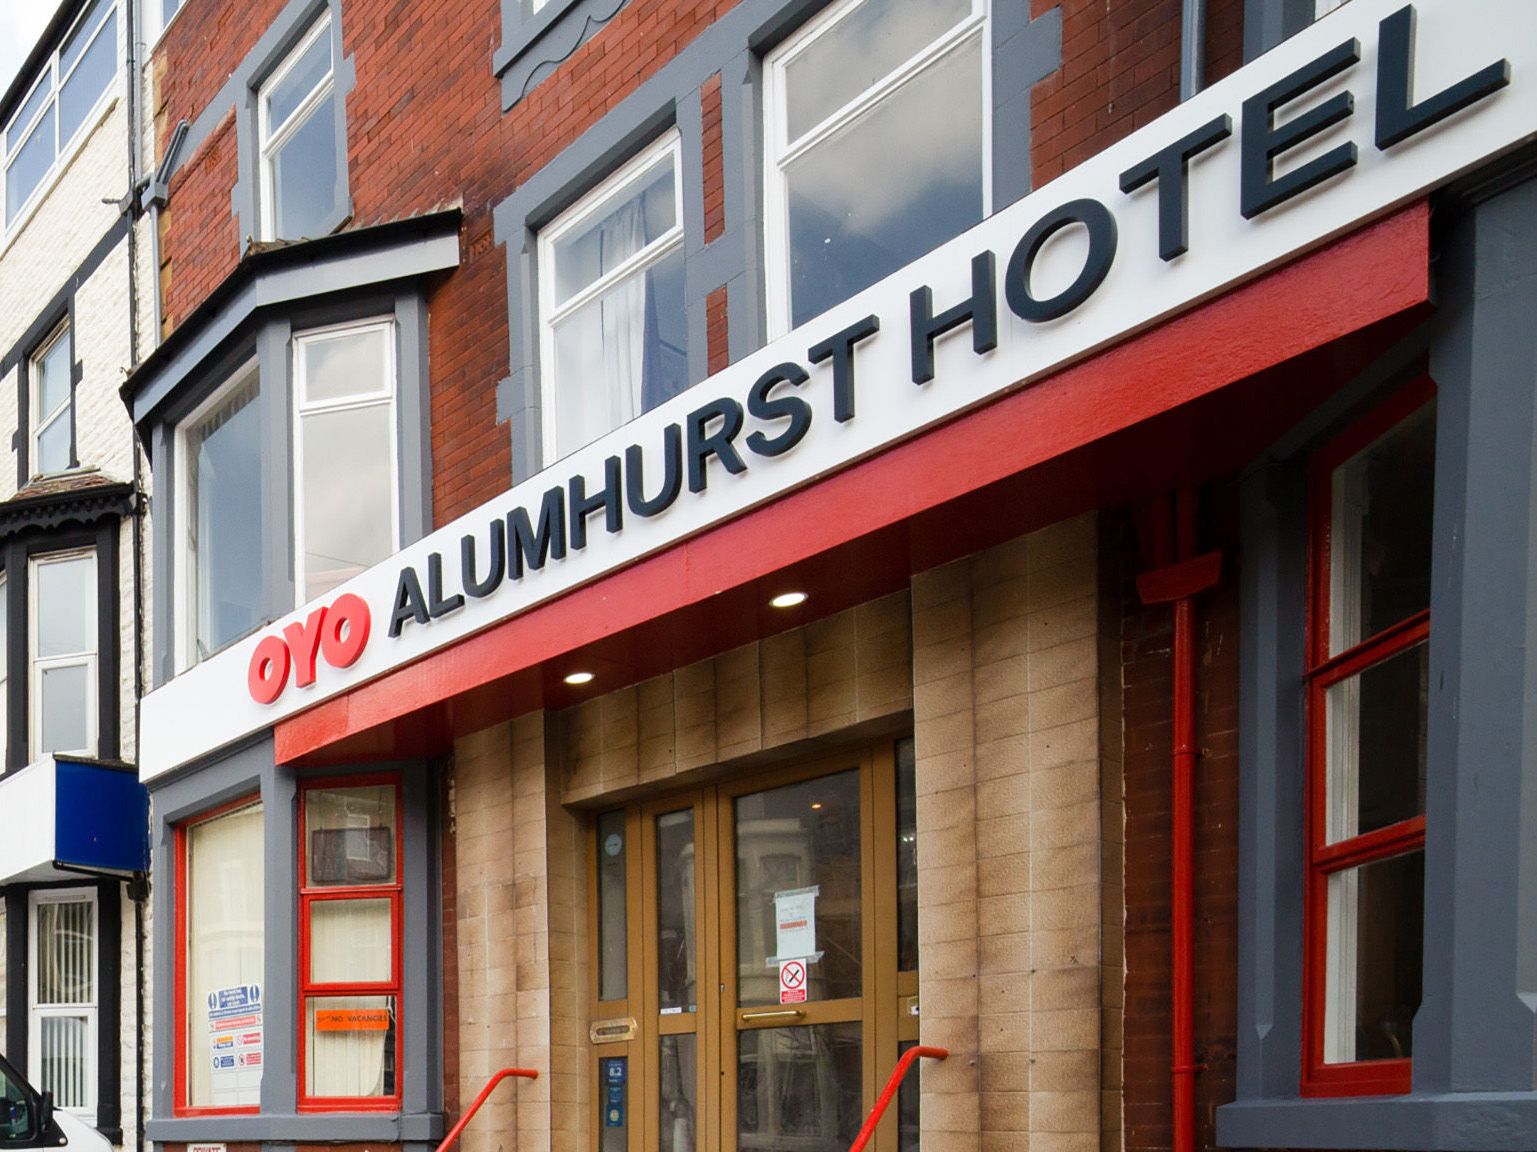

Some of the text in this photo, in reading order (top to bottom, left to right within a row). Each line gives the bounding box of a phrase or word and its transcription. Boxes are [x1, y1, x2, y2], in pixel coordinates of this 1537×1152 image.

[248, 3, 1511, 704] OYO ALUMHURST HOTEL
[609, 1067, 622, 1077] 8.2
